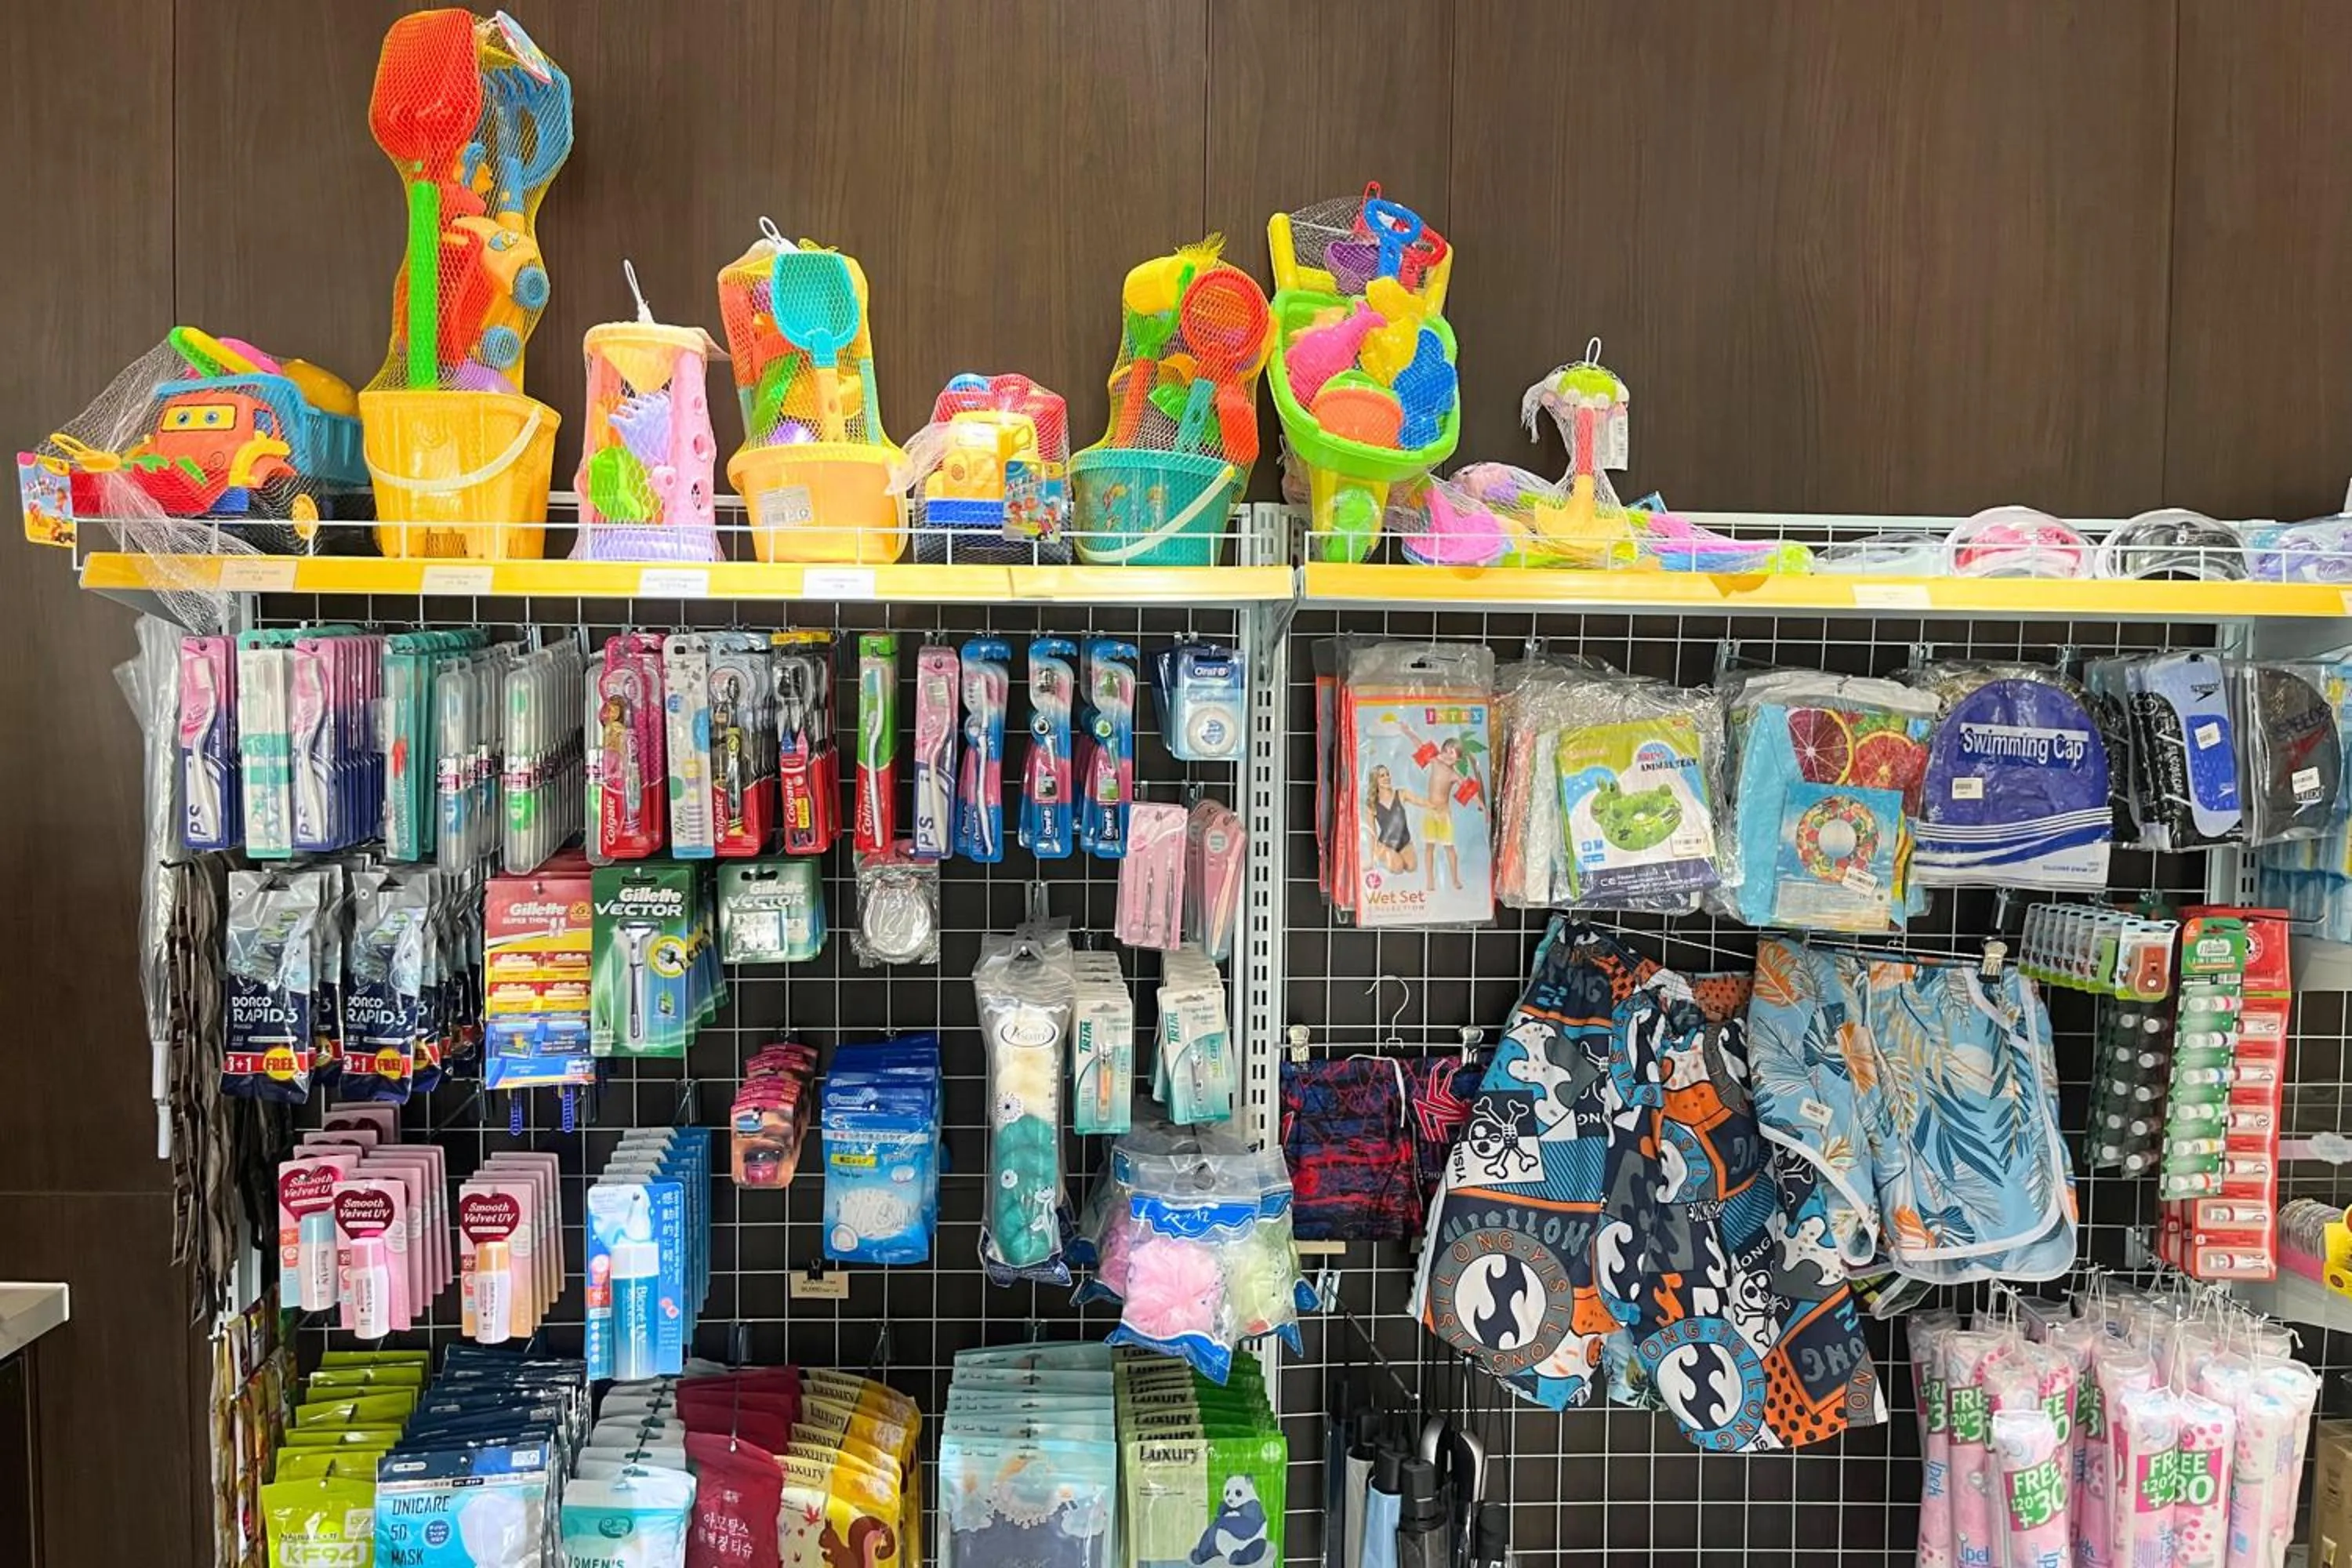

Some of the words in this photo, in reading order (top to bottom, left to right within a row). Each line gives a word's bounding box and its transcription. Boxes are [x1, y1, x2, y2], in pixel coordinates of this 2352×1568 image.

[1193, 666, 1229, 676] Oral-B
[1425, 708, 1483, 724] INTEX
[1962, 728, 2049, 765] Swimming
[2053, 734, 2084, 768] Cap
[786, 778, 796, 822] Colgate
[190, 804, 206, 837] PS
[606, 796, 615, 845] Colgate
[715, 793, 727, 843] Colgate
[1043, 809, 1052, 835] Oral-B
[1105, 810, 1113, 837] Oral-B
[919, 816, 934, 847] PS
[619, 887, 683, 903] Gillette
[750, 880, 804, 894] Gillette
[727, 893, 805, 909] VECTOR
[1367, 891, 1397, 904] Wet
[1400, 889, 1425, 903] Set
[510, 901, 568, 916] Gillette
[593, 899, 683, 916] VECTOR
[231, 996, 272, 1007] DORCO
[1166, 1012, 1180, 1044] TRIM
[1079, 1020, 1092, 1054] TRIM
[227, 1055, 252, 1072] 3+1
[266, 1057, 296, 1071] FREE
[343, 1055, 366, 1072] 3+1
[284, 1186, 320, 1197] Velvet
[343, 1197, 384, 1208] Smooth
[468, 1202, 510, 1212] Smooth
[339, 1207, 372, 1218] Velvet
[373, 1207, 390, 1218] UV
[463, 1213, 496, 1223] Velvet
[497, 1213, 515, 1222] UV
[809, 1402, 845, 1427] Luxury
[1134, 1413, 1192, 1425] Luxury
[1139, 1445, 1200, 1464] Luxury
[2013, 1461, 2060, 1496] FREE
[392, 1494, 452, 1515] UNICARE
[2011, 1495, 2034, 1512] 120
[287, 1546, 358, 1563] KF94
[390, 1548, 424, 1566] MASK
